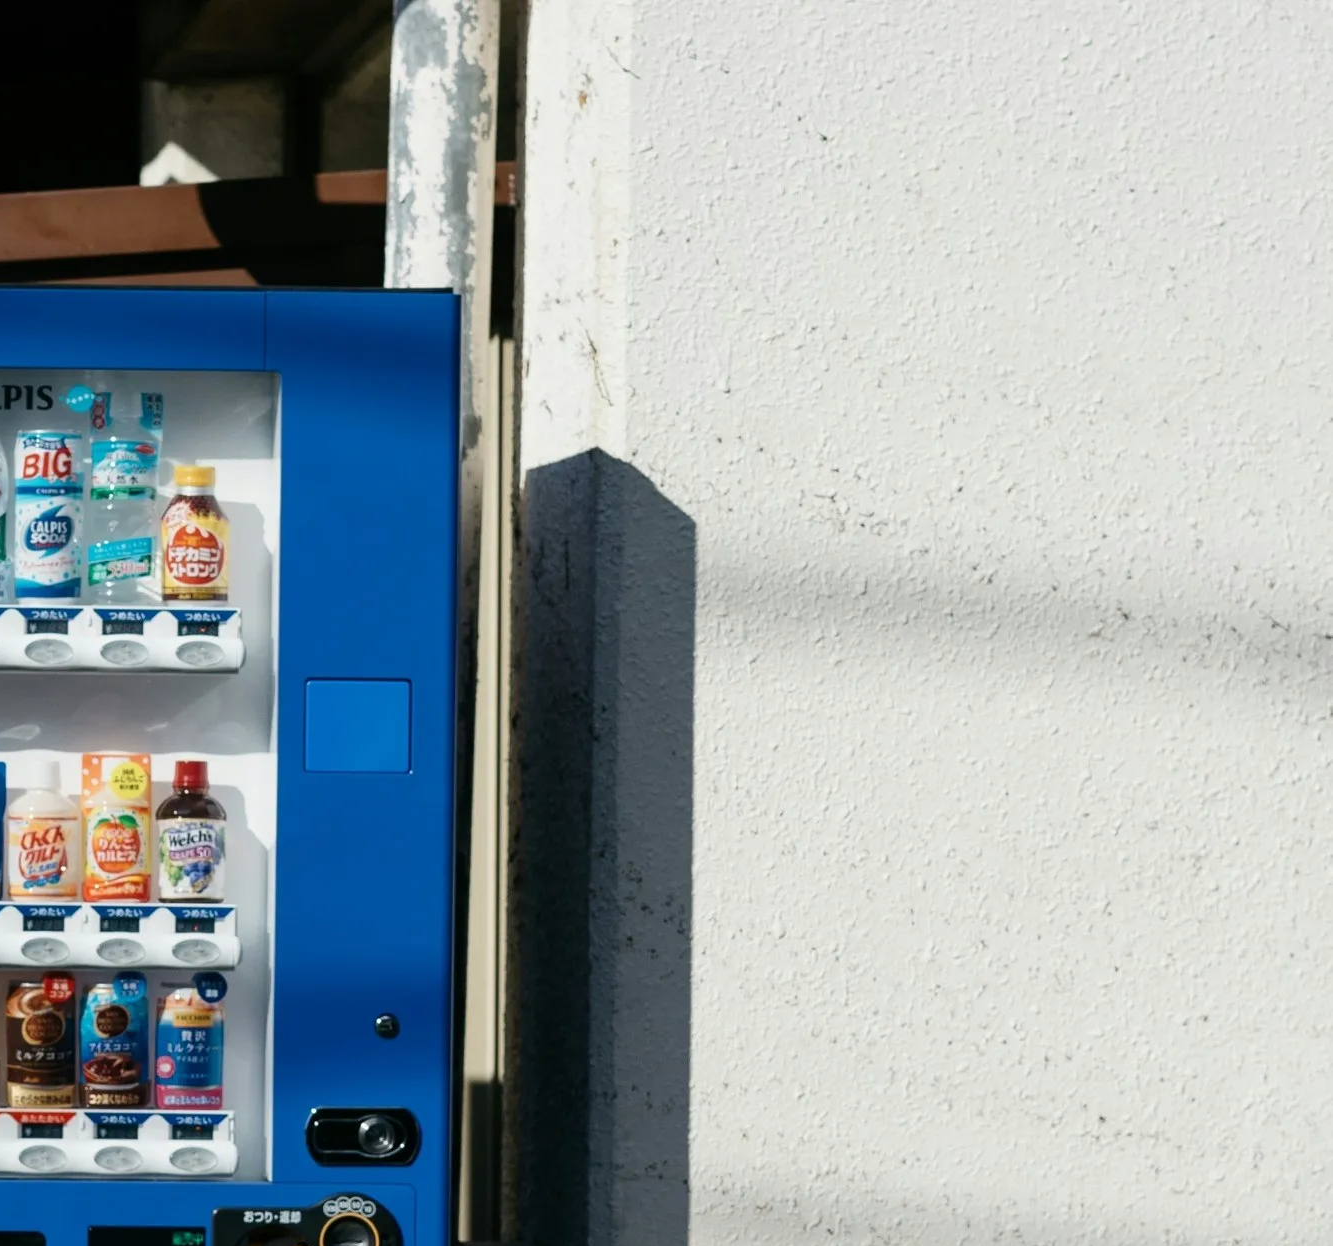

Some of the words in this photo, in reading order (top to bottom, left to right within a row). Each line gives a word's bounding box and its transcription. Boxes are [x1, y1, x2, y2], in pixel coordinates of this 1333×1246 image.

[23, 448, 72, 479] BIG
[30, 520, 67, 532] CALPIS
[29, 533, 67, 545] SODA
[32, 611, 67, 620] つめたい
[110, 612, 145, 621] つめたい
[186, 613, 222, 622] つめたい
[168, 830, 213, 847] Welch's
[30, 908, 66, 917] つめたい
[107, 909, 143, 918] つめたい
[183, 910, 218, 919] つめたい
[166, 1042, 221, 1053] ミルクティー
[22, 1115, 66, 1124] あたたかい
[100, 1116, 136, 1125] つめたい
[177, 1116, 213, 1126] つめたい
